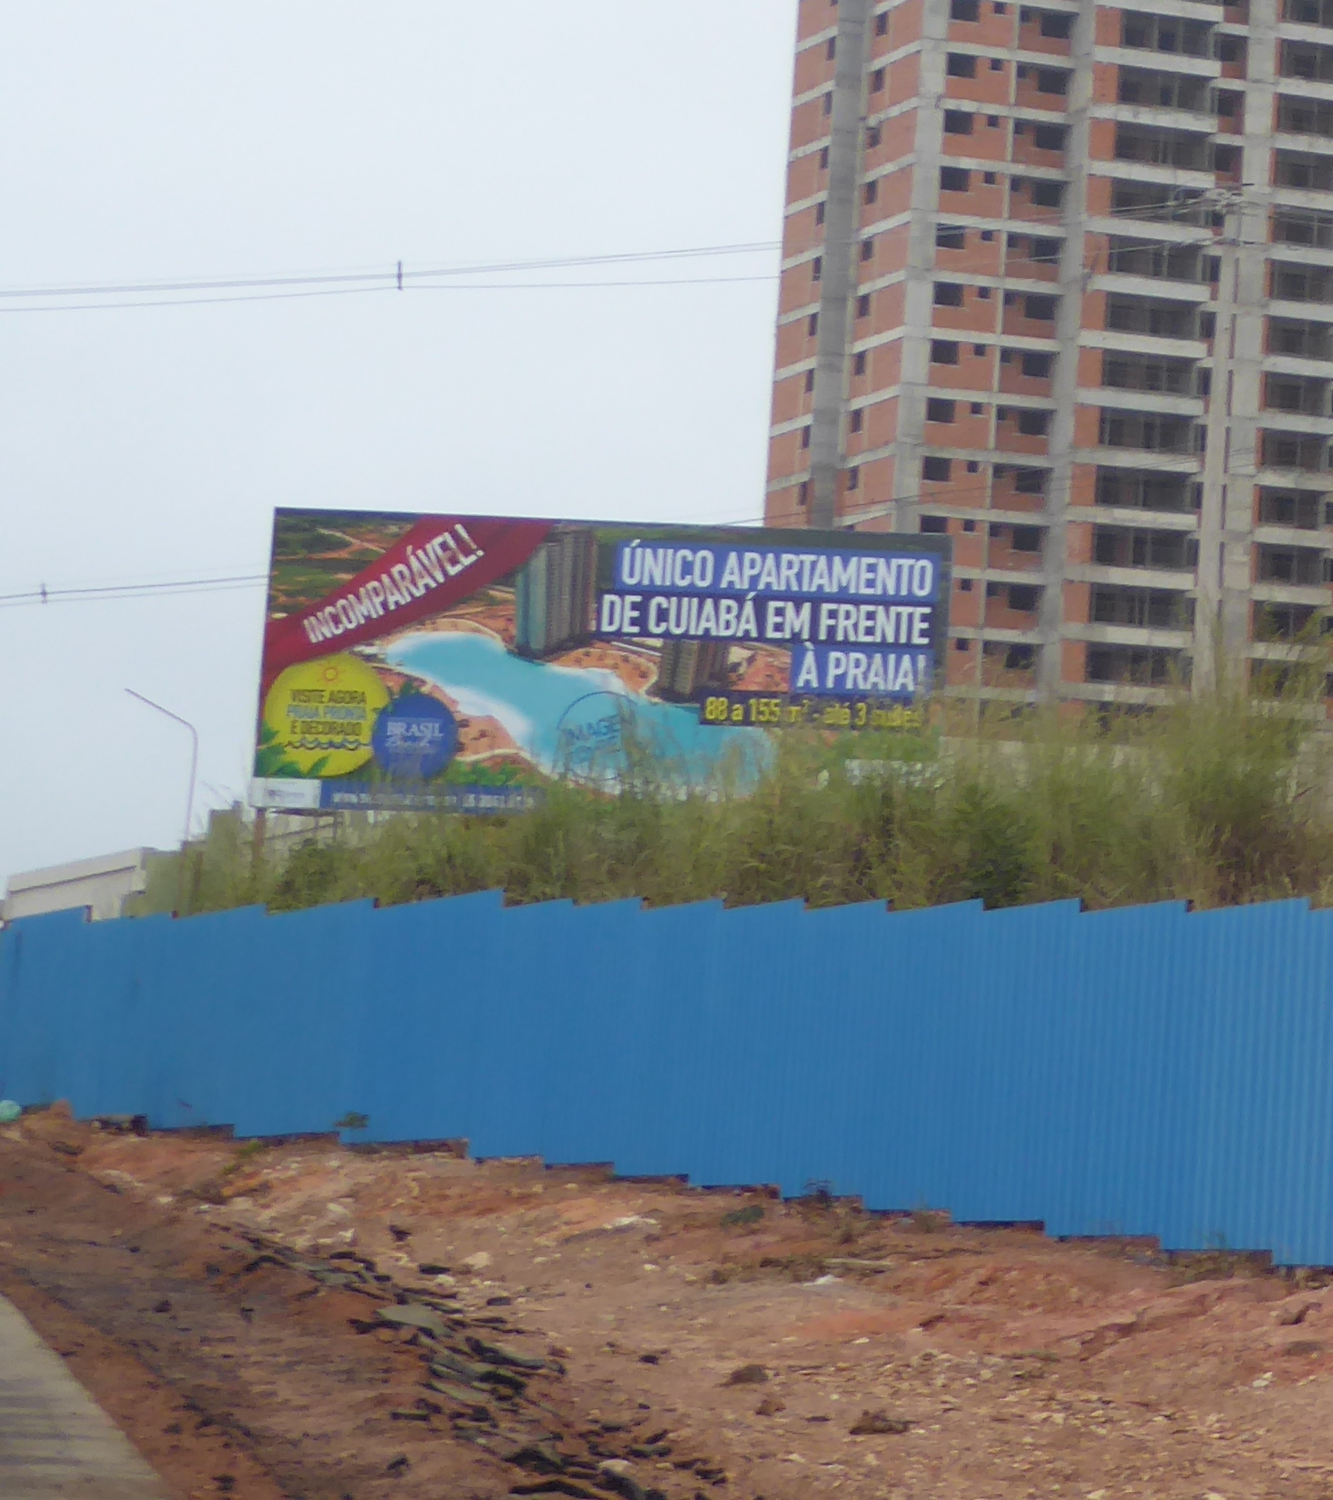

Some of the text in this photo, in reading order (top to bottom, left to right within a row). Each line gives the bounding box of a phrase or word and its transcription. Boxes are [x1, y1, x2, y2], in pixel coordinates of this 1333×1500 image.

[303, 523, 485, 643] INCOMPARÁVEL!
[621, 539, 934, 597] ÚNICO APARTAMENTO
[600, 591, 932, 645] DE CUIABÁ EM FRENTE
[796, 641, 928, 693] À PRAIA!
[386, 721, 444, 738] BRASIL
[705, 696, 729, 721] 88
[731, 704, 744, 721] a
[748, 698, 781, 722] 155
[854, 702, 867, 726] 3
